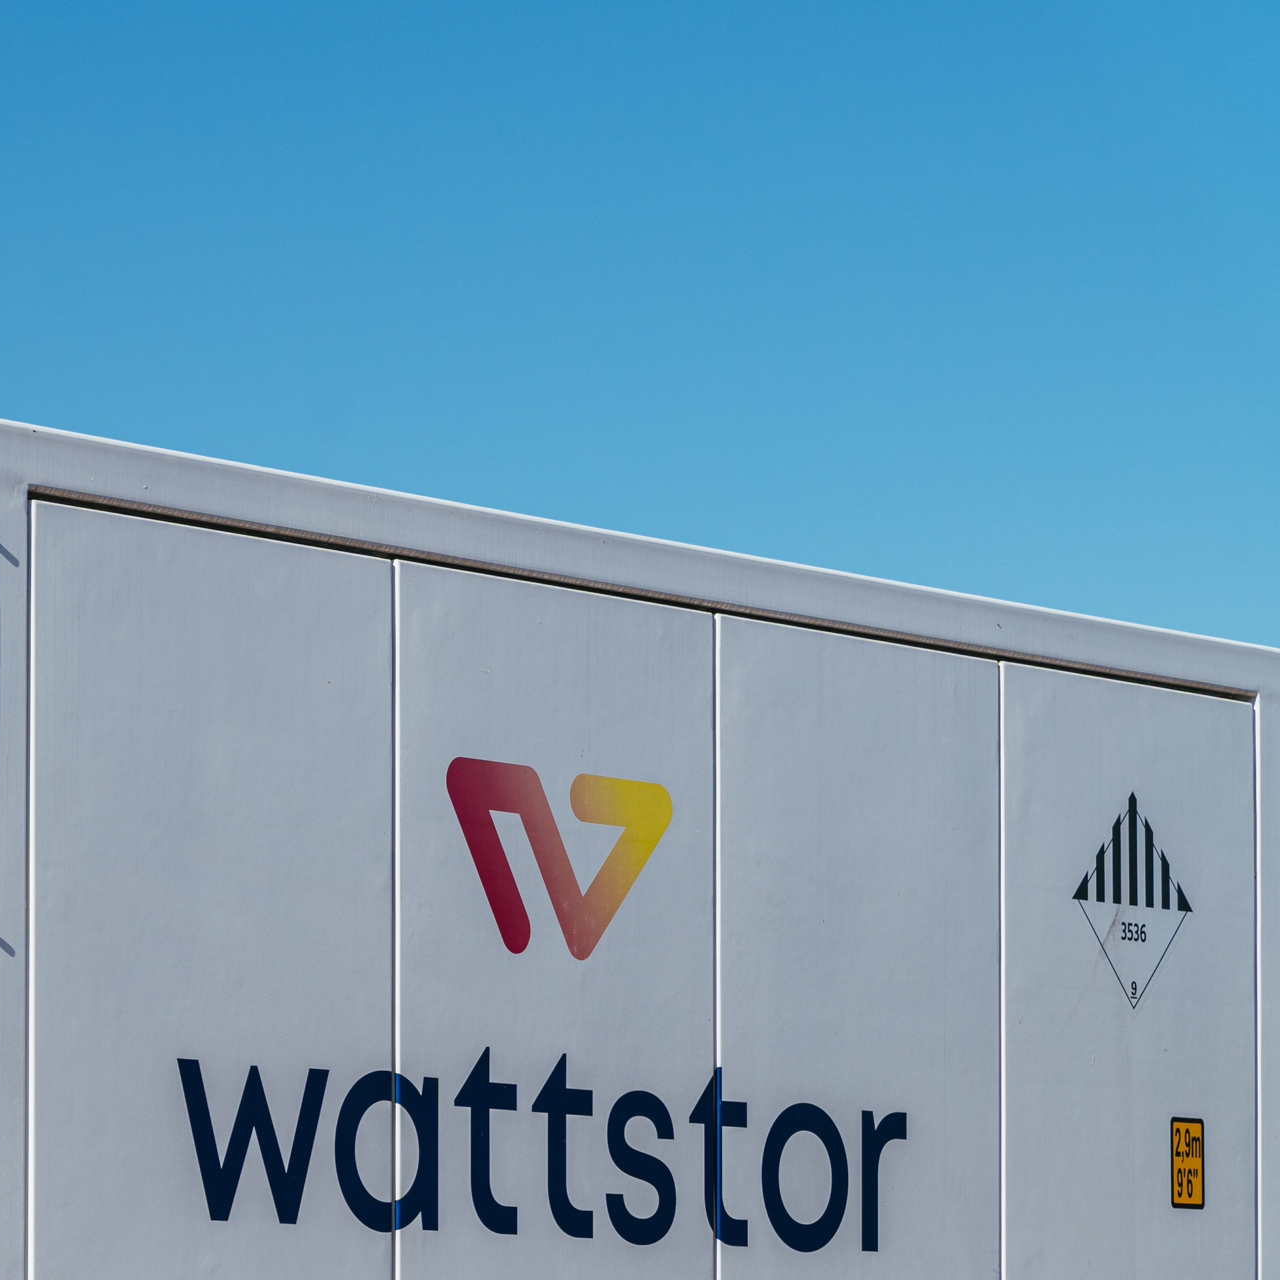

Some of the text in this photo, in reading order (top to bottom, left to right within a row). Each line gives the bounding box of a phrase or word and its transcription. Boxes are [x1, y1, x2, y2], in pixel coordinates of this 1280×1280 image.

[1121, 921, 1147, 943] 3536
[1130, 981, 1138, 996] 9
[176, 1046, 907, 1253] wattstor
[1174, 1127, 1201, 1163] 2,9m
